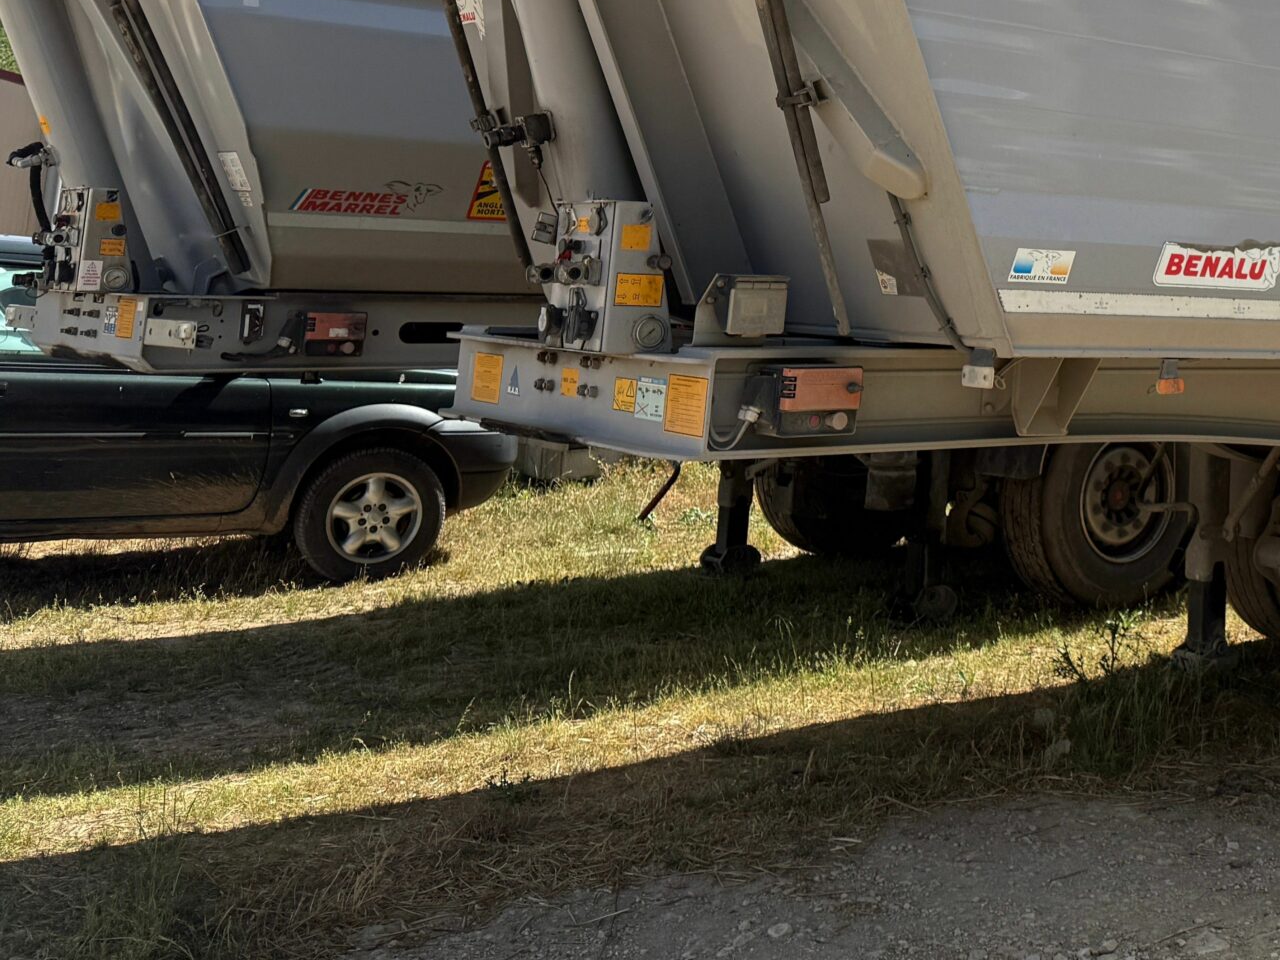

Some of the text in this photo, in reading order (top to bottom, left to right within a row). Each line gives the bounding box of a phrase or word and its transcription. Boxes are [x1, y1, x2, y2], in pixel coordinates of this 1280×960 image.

[311, 189, 408, 205] BENNES
[302, 201, 401, 216] MARREL
[1165, 253, 1267, 280] BENALU
